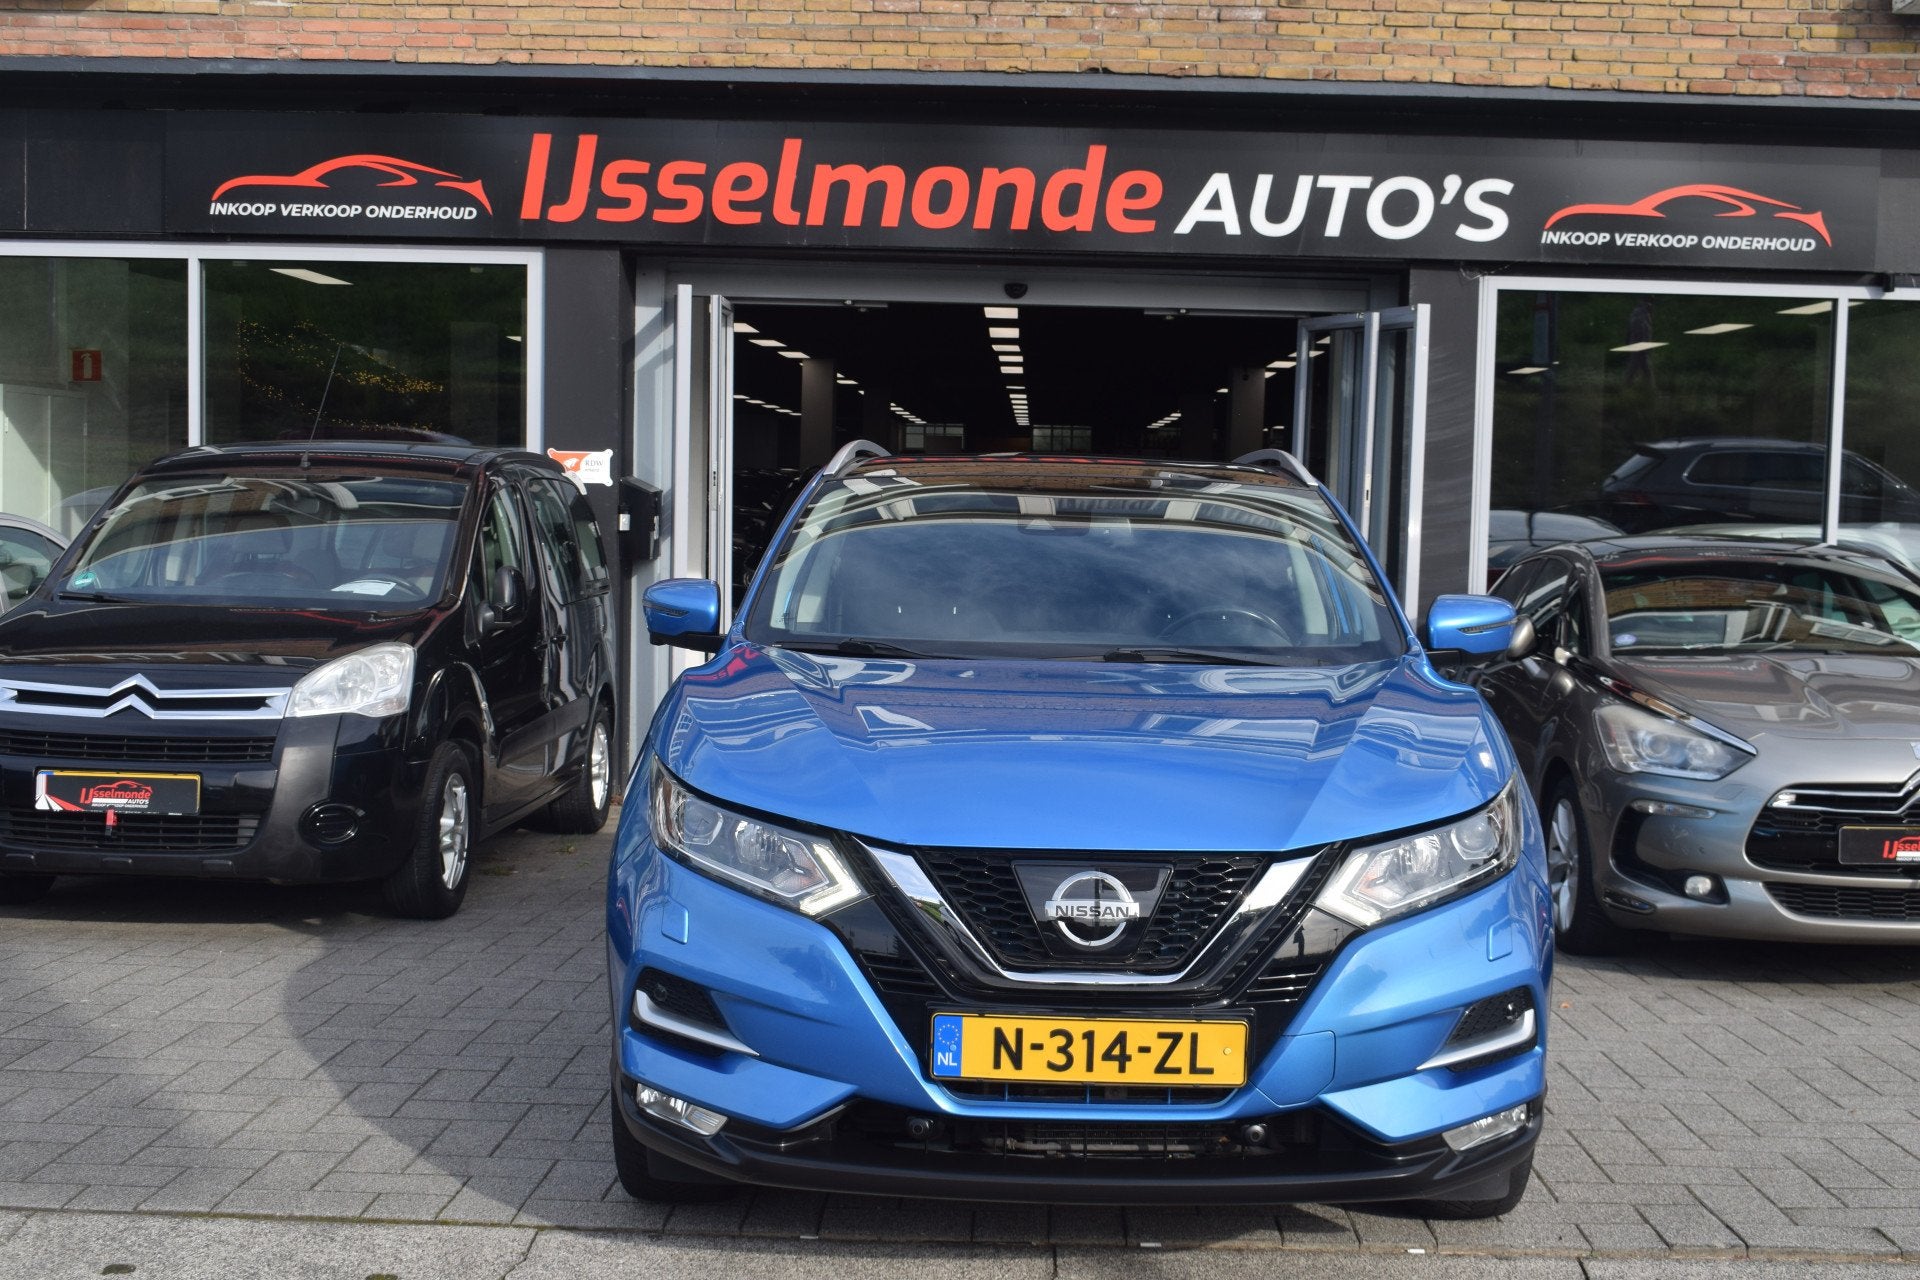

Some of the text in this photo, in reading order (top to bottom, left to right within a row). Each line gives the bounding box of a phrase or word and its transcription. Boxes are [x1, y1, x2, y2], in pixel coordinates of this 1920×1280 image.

[520, 133, 1515, 243] IJsselmonde AUTO'S
[209, 202, 478, 220] INKOOP VERKOOP ONDERHOUD
[1541, 231, 1816, 252] INKOOP VERKOOP ONDERHOUD
[80, 788, 151, 804] IJsselmonde
[1055, 905, 1129, 918] NISSAN
[937, 1052, 957, 1067] NL
[993, 1026, 1214, 1075] N-314-ZL
